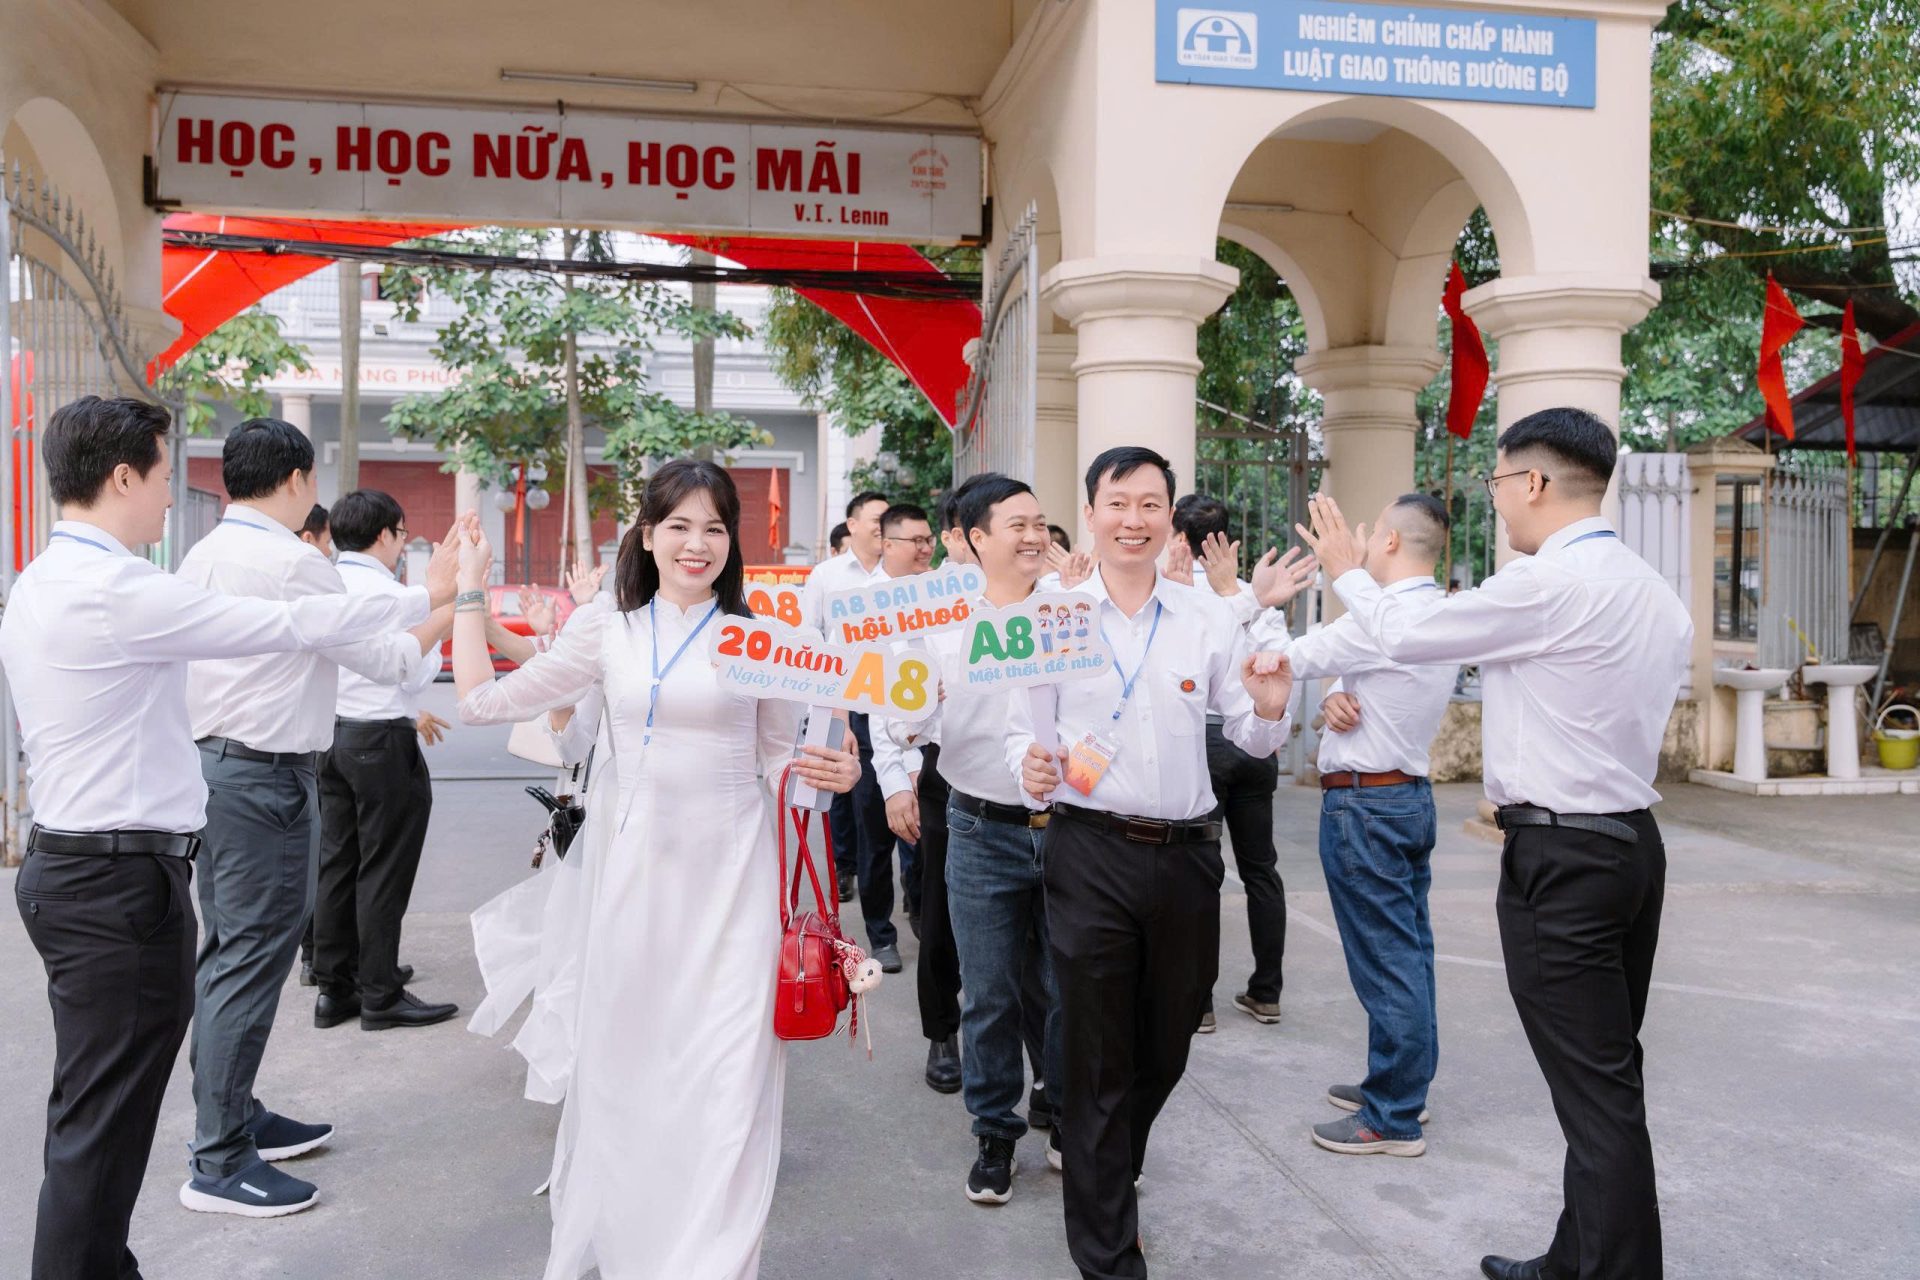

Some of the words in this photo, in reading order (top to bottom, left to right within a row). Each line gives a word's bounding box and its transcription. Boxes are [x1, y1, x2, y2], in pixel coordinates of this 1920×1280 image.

[1299, 12, 1376, 44] NGHIÊM
[1381, 13, 1441, 48] CHỈNH
[1446, 20, 1497, 51] CHẤP
[1501, 24, 1554, 55] HÀNH
[1283, 48, 1335, 81] LUẬT
[1339, 54, 1388, 81] GIAO
[1393, 54, 1460, 86] THÔNG
[1465, 57, 1537, 91] ĐƯỜNG
[1541, 62, 1569, 97] BỘ
[337, 126, 450, 185] HỌC
[628, 141, 735, 200] HỌC
[757, 141, 860, 195] MÃI
[841, 206, 888, 226] Lenin
[748, 589, 802, 628] A8
[831, 595, 866, 618] A8
[873, 584, 918, 609] ĐẠI
[926, 570, 978, 599] NÁO
[842, 615, 893, 643] hội
[896, 598, 973, 632] khoá
[969, 616, 1035, 664] A8
[718, 626, 771, 661] 20
[773, 645, 848, 676] năm
[843, 652, 928, 711] A8
[726, 665, 776, 688] Ngày
[781, 676, 812, 692] trở
[816, 680, 841, 697] về
[968, 667, 1002, 684] Một
[1005, 662, 1041, 678] thời
[1044, 654, 1067, 673] để
